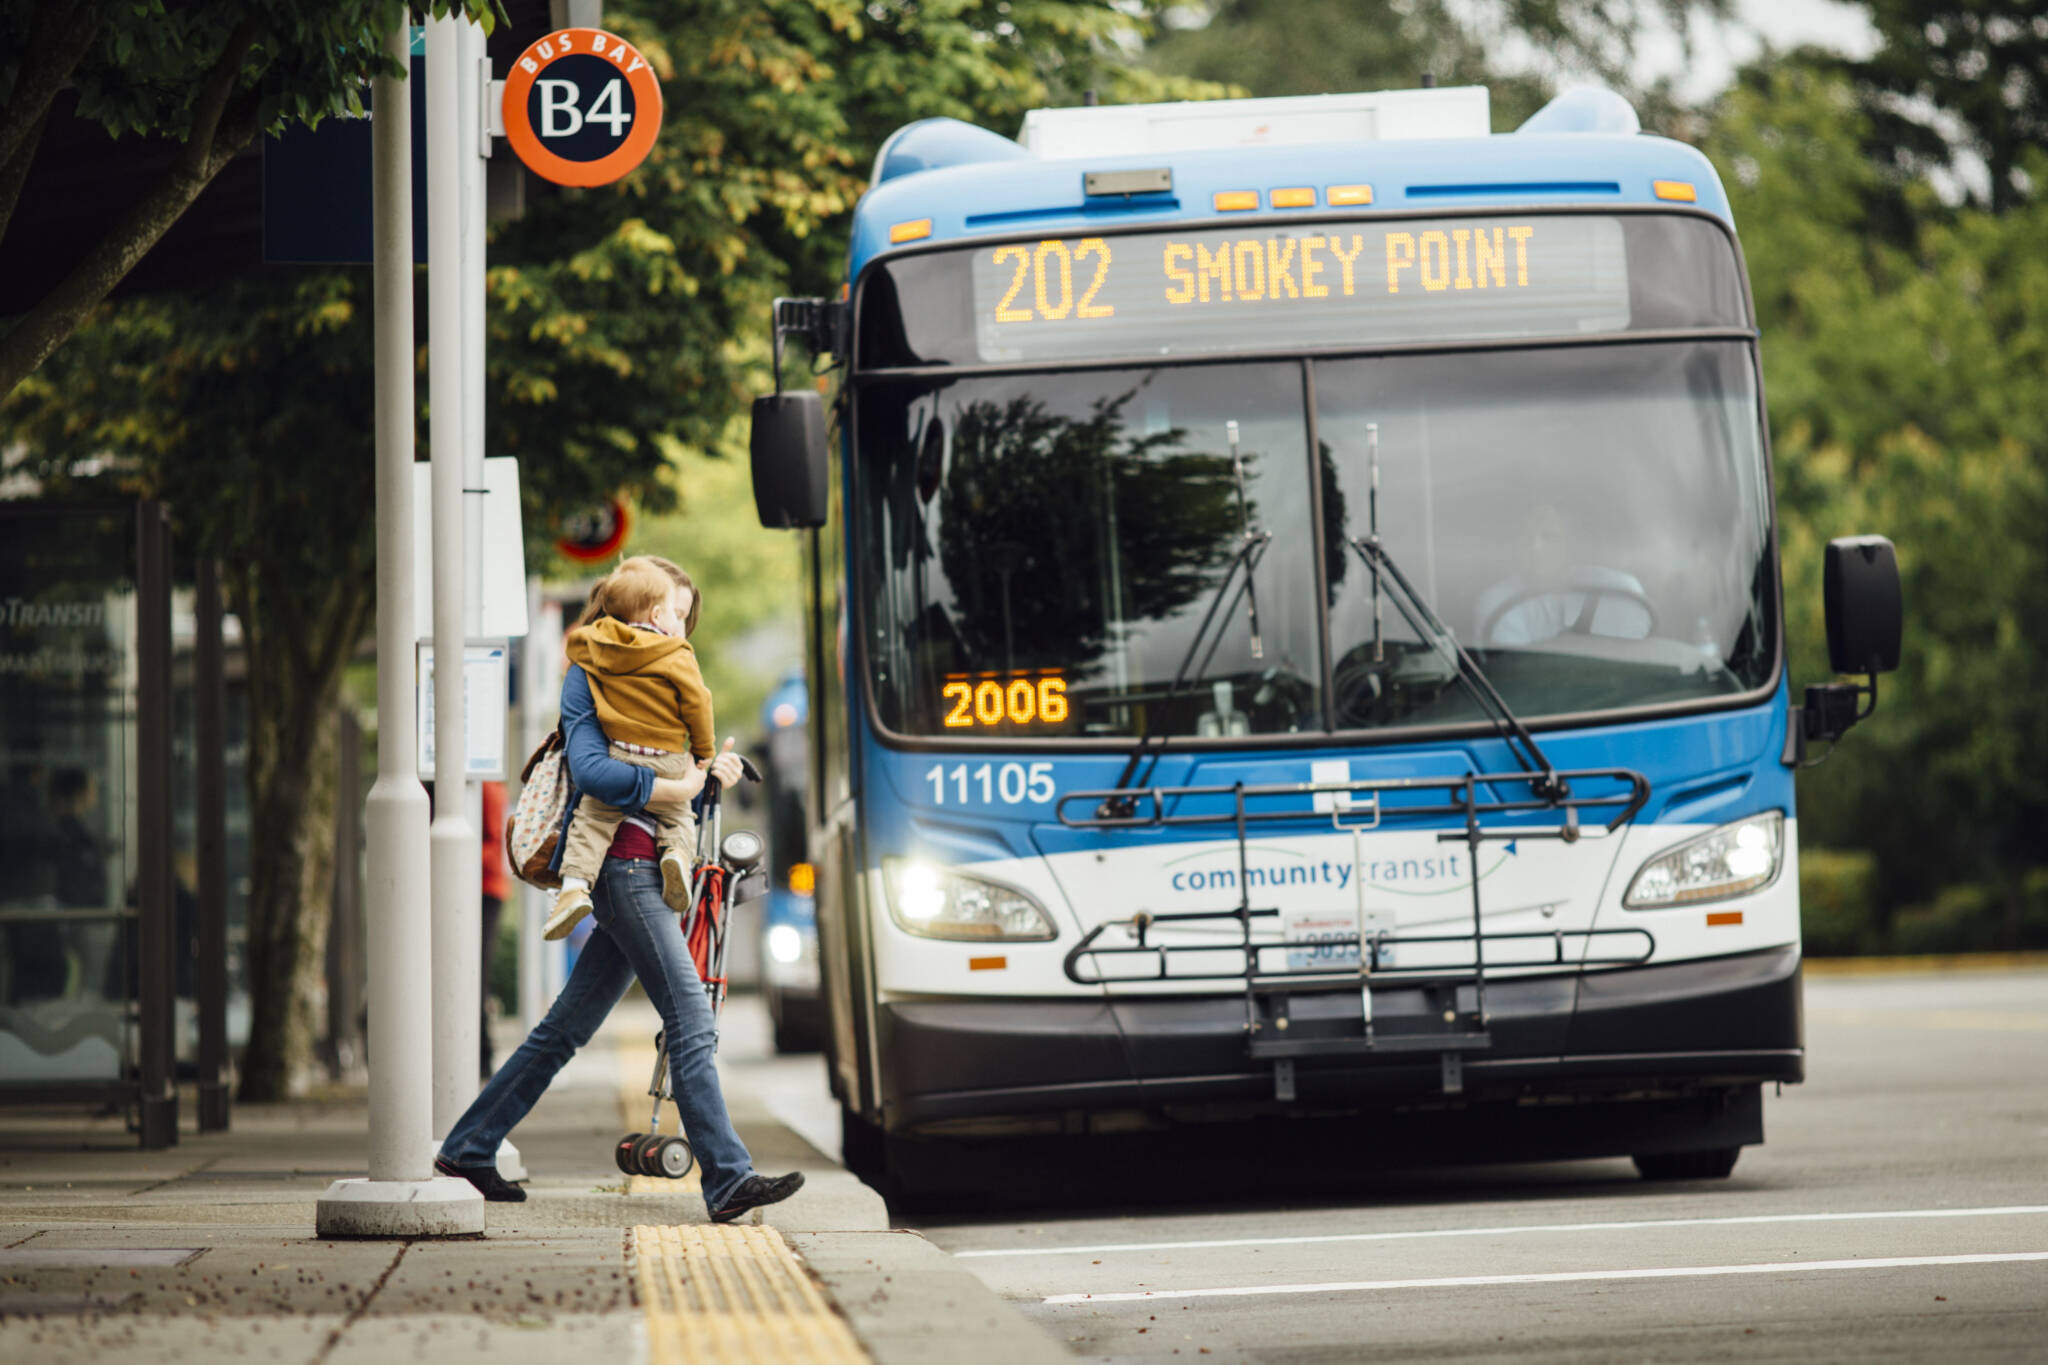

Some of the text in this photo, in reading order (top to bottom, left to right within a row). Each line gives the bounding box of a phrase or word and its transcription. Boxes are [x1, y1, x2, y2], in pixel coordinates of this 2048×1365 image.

[519, 33, 644, 75] BUS BAY
[535, 78, 632, 137] B4
[993, 226, 1533, 322] 202 SMOKEY POINT
[943, 677, 1069, 728] 2006
[926, 762, 1056, 805] 11105
